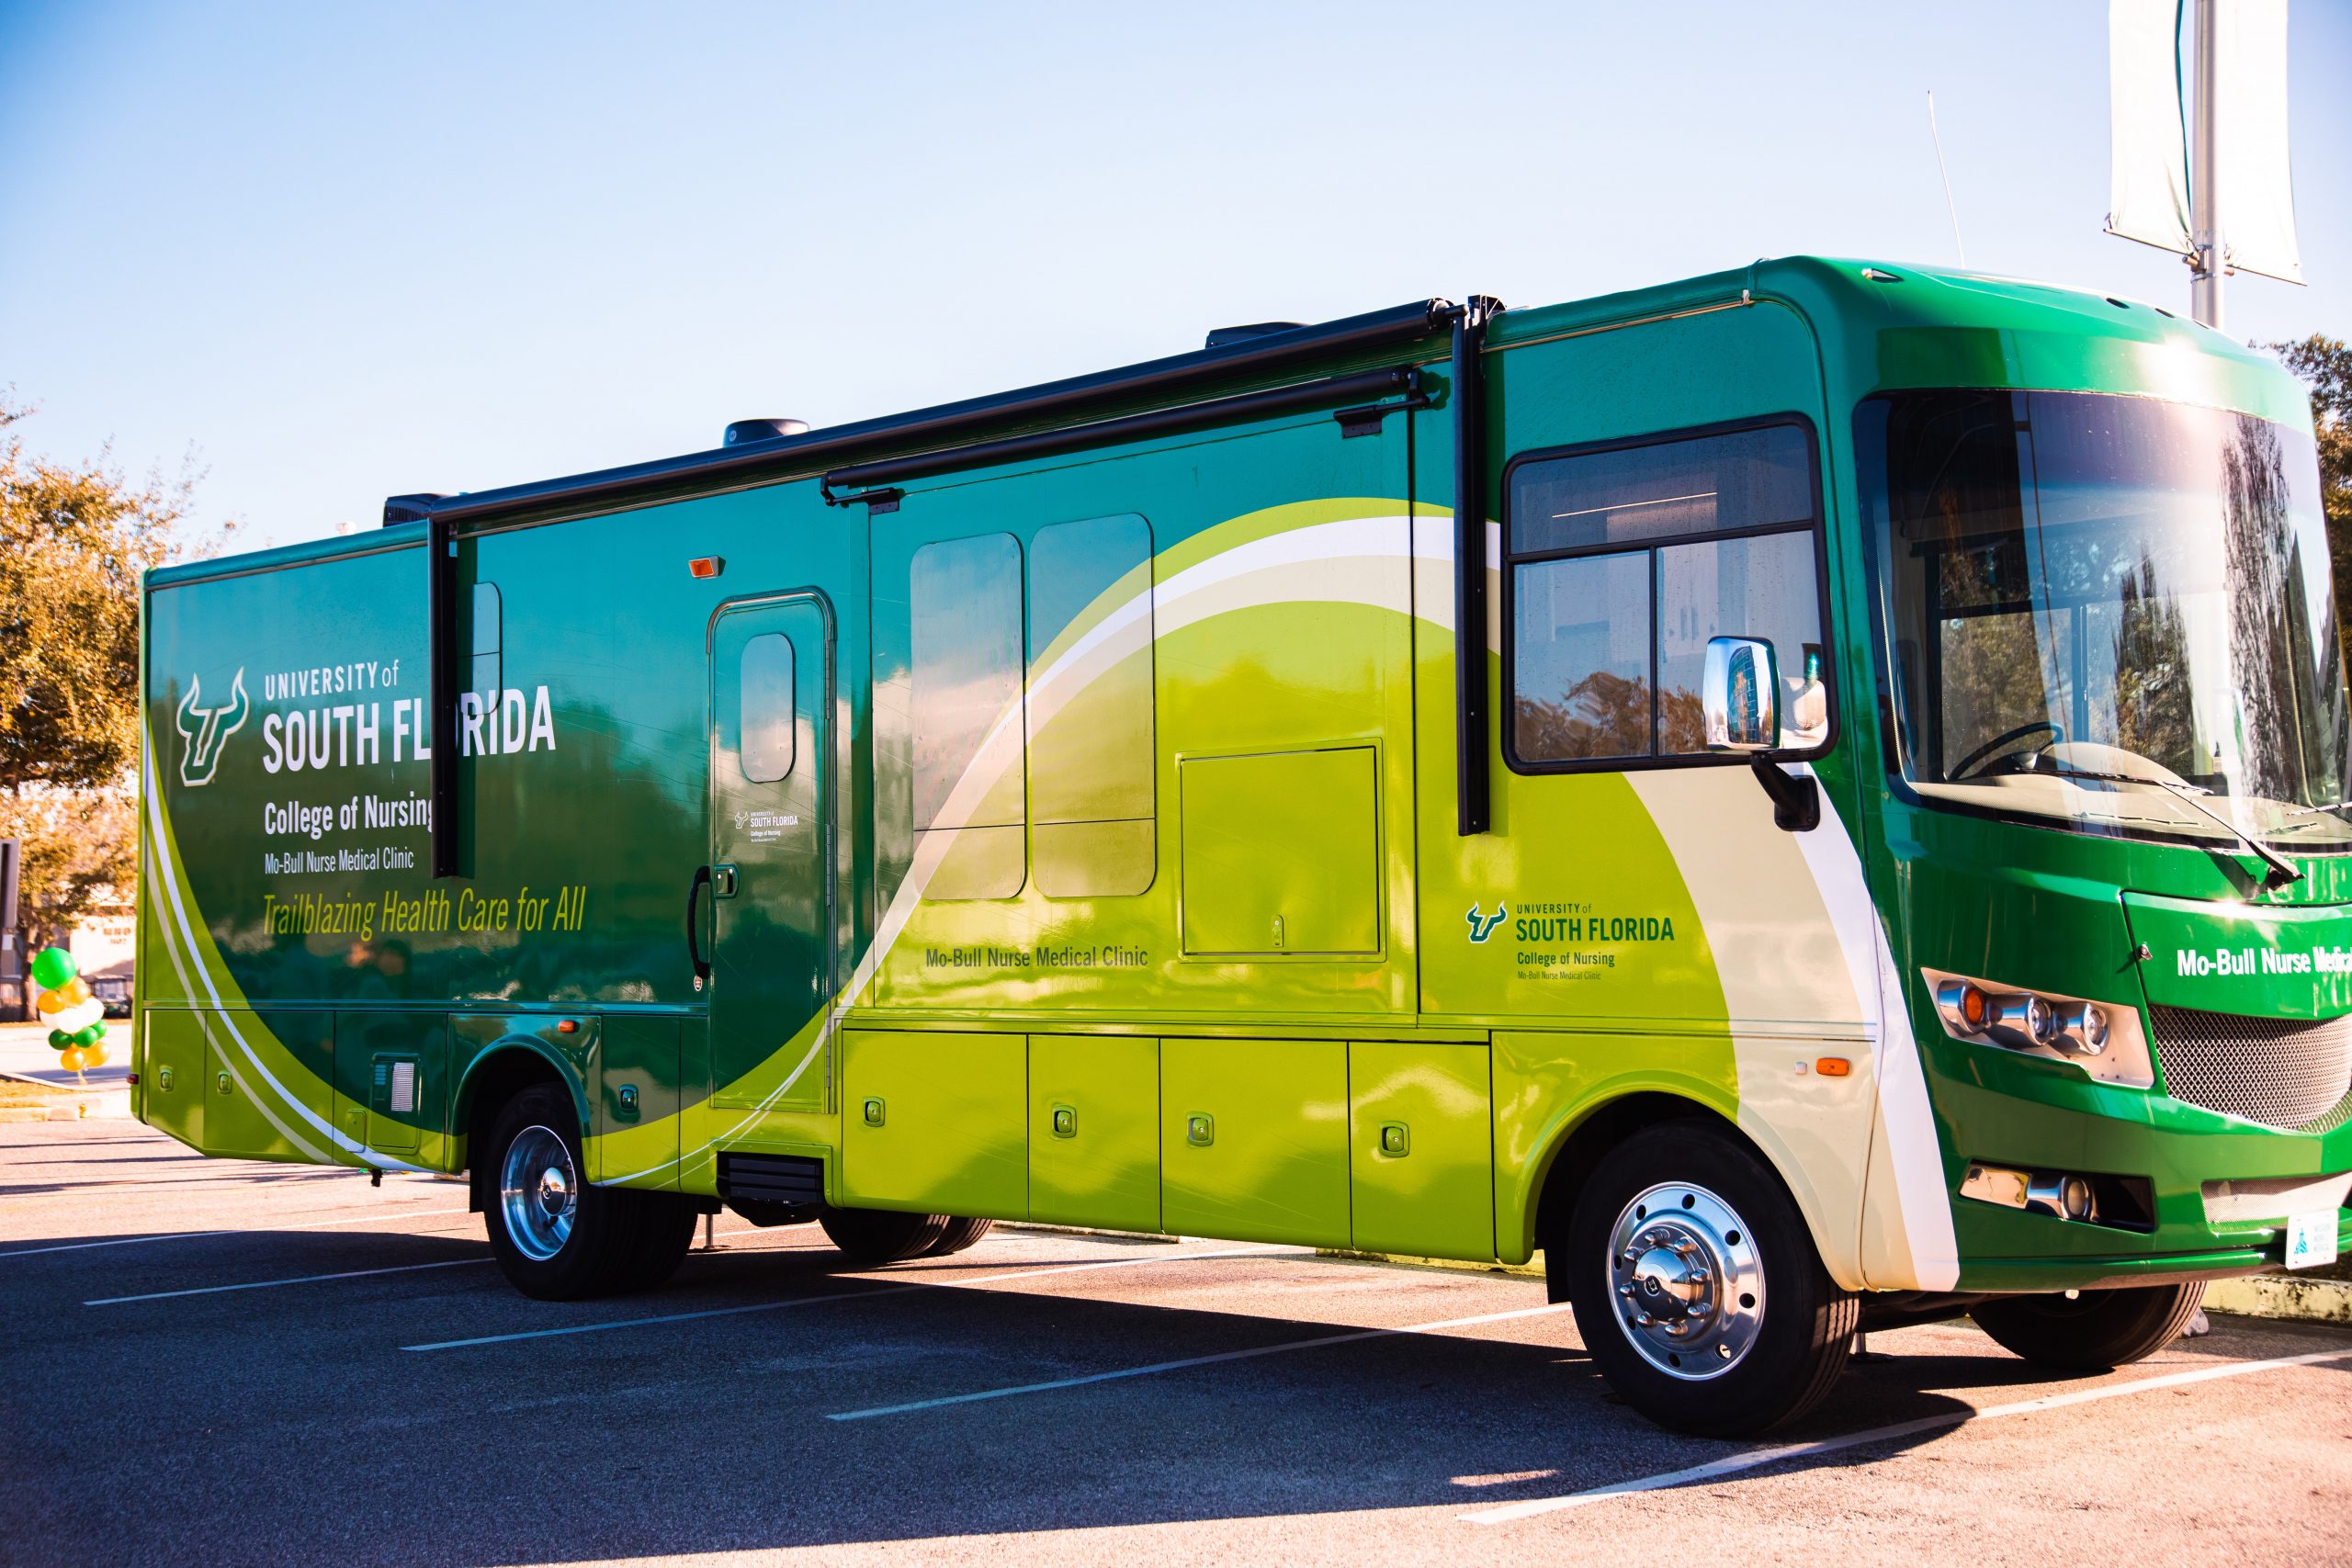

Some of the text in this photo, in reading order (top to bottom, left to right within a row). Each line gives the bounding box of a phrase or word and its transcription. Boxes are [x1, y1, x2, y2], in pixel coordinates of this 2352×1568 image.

[265, 659, 399, 701] UNIVERSITY of
[263, 685, 556, 774] SOUTH FLRIDA
[265, 800, 333, 840] College
[340, 795, 358, 830] of
[750, 816, 798, 828] SOUTH FLORIDA
[265, 846, 413, 874] Mo-Bull Nurse Medical Clinic
[264, 886, 586, 942] Trailblazing Health Care for All
[1517, 903, 1592, 914] UNIVERSITY of
[1516, 917, 1675, 942] SOUTH FLORIDA
[926, 945, 1148, 967] Mo-Bull Nurse Medical Clinic
[1517, 951, 1615, 968] College of Nursing
[2177, 948, 2256, 976] Mo-Bull
[2261, 947, 2312, 974] Nurse
[1518, 971, 1601, 980] Mo-Bull Nurse Medical Clinic
